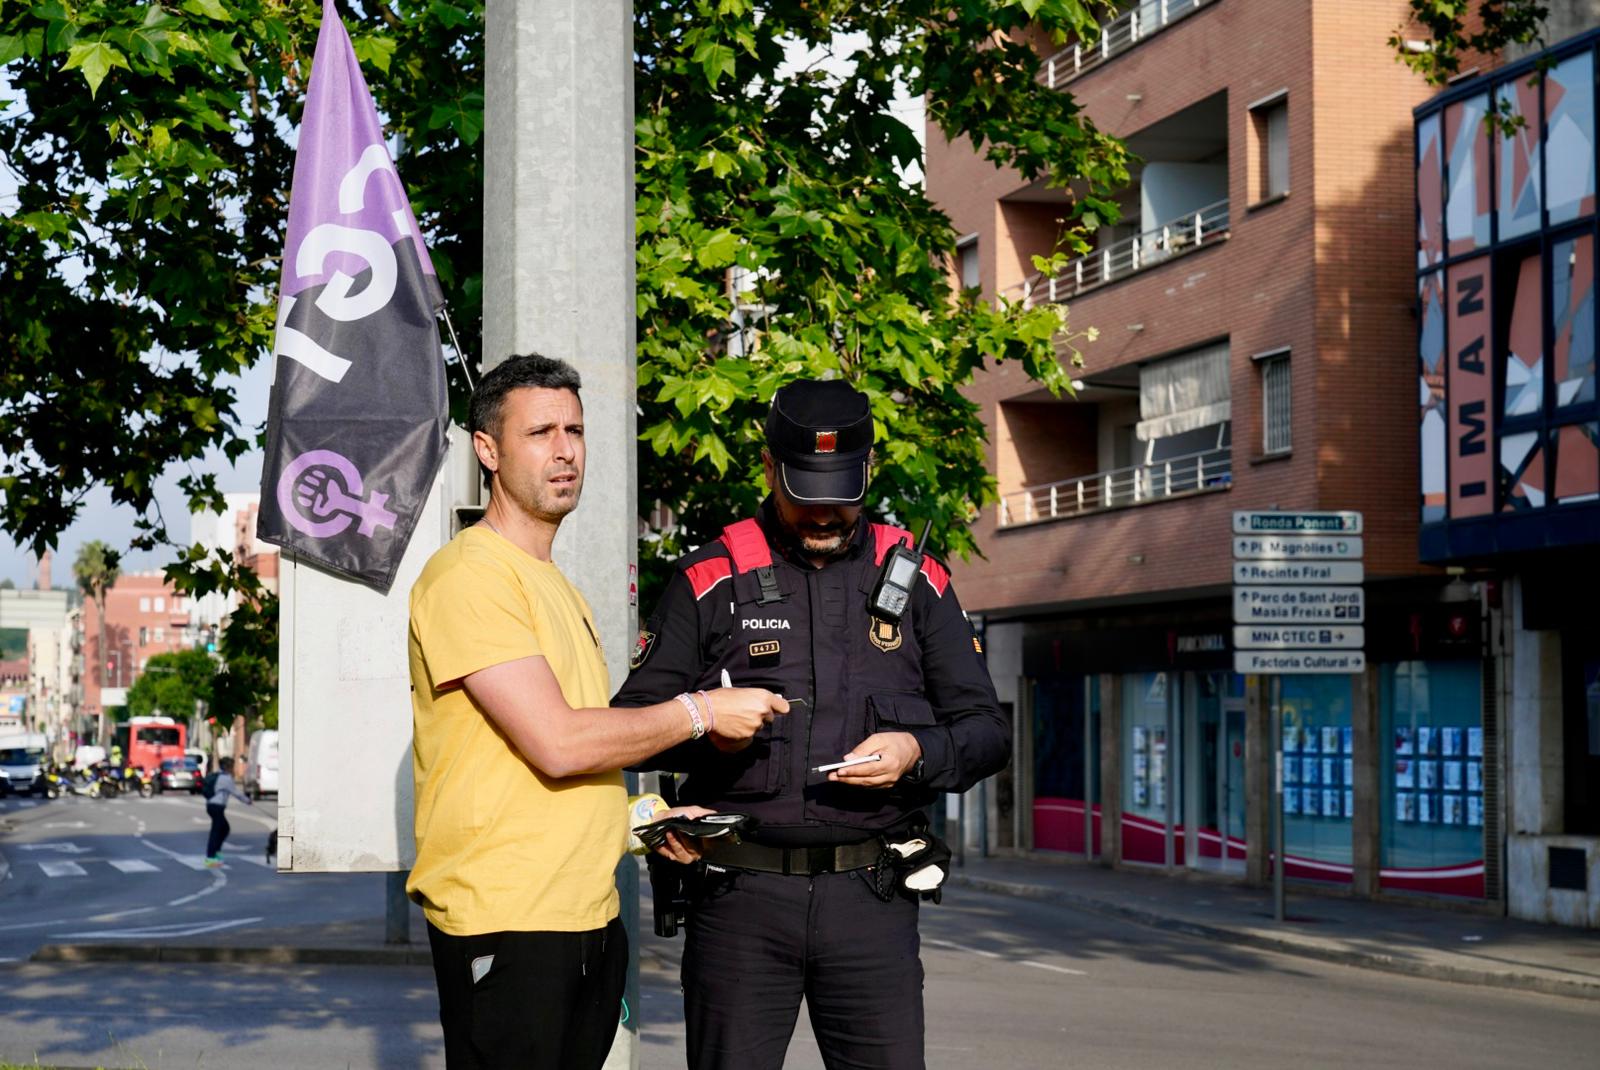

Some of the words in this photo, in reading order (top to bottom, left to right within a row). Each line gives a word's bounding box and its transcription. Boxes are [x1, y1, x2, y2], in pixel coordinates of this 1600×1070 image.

[1457, 274, 1487, 499] IMAN
[1252, 516, 1292, 528] Ronda
[1296, 516, 1339, 528] Ponent
[1270, 541, 1333, 555] Magnòlies
[1251, 567, 1299, 578] Recinte
[1303, 566, 1331, 578] Firal
[1252, 592, 1279, 603] Parc
[1282, 592, 1297, 603] de
[1300, 592, 1326, 603] Sant
[1329, 592, 1359, 604] Jordi
[1252, 606, 1288, 617] Masia
[1292, 606, 1331, 617] Freixa
[741, 618, 791, 630] POLICIA
[1252, 631, 1316, 643] MNACTEC
[1252, 657, 1300, 668] Factoria
[1304, 656, 1348, 668] Cultural
